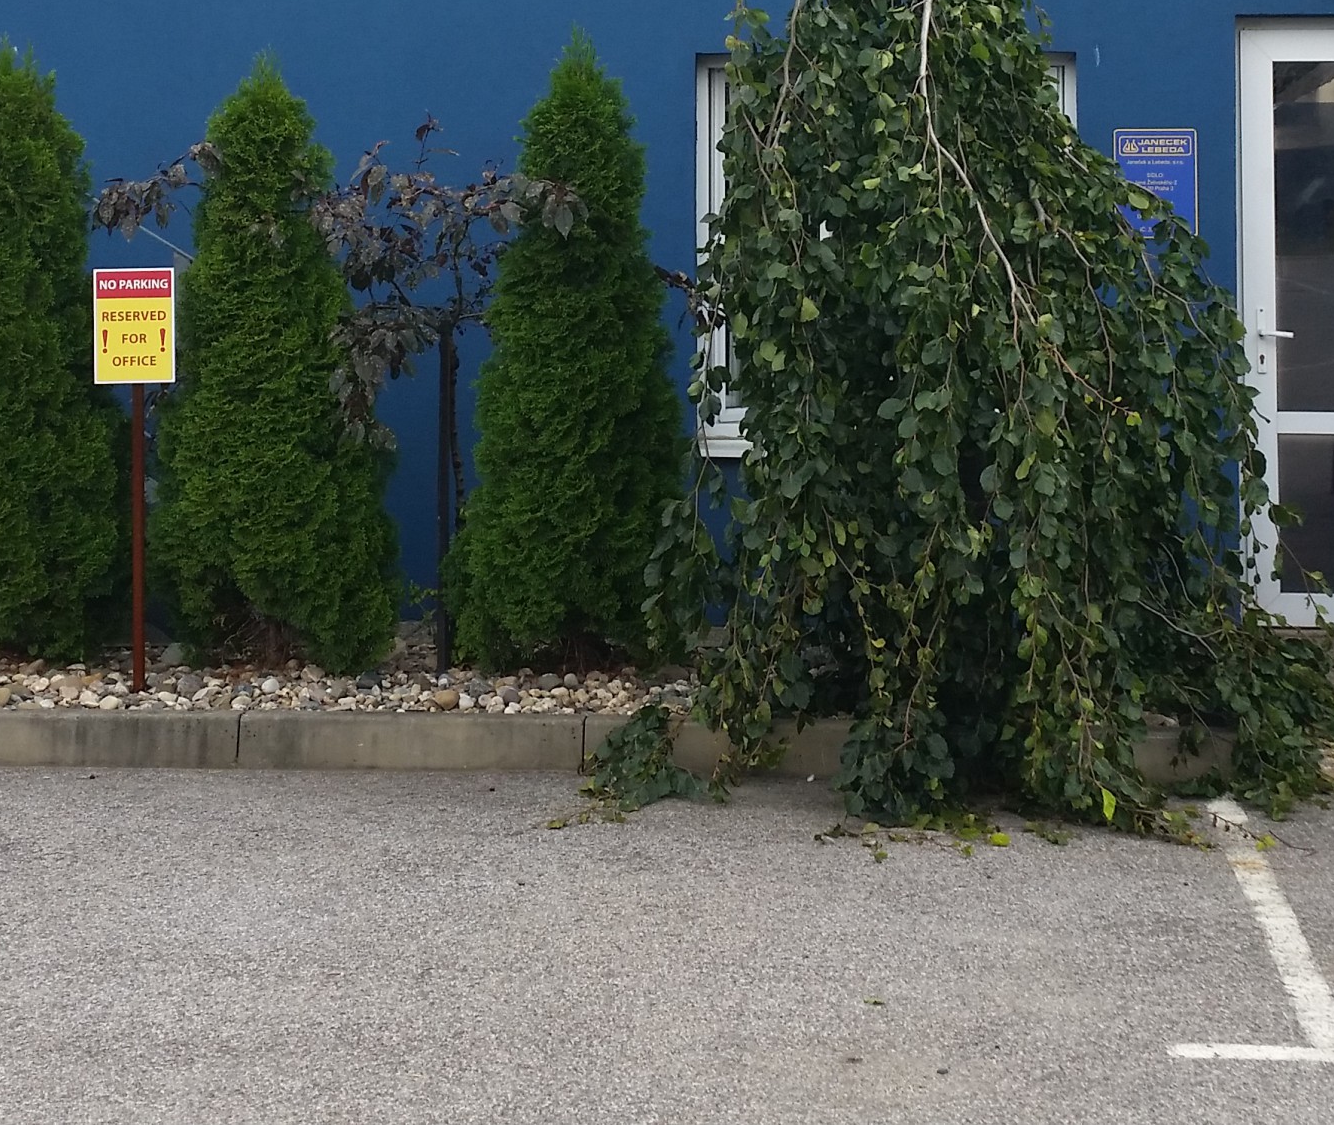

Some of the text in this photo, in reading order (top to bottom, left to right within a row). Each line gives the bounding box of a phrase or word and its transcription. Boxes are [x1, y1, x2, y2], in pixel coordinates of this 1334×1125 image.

[99, 279, 169, 290] NO PARKING
[101, 311, 167, 322] RESERVED
[122, 333, 147, 344] FOR
[112, 355, 157, 366] OFFICE
